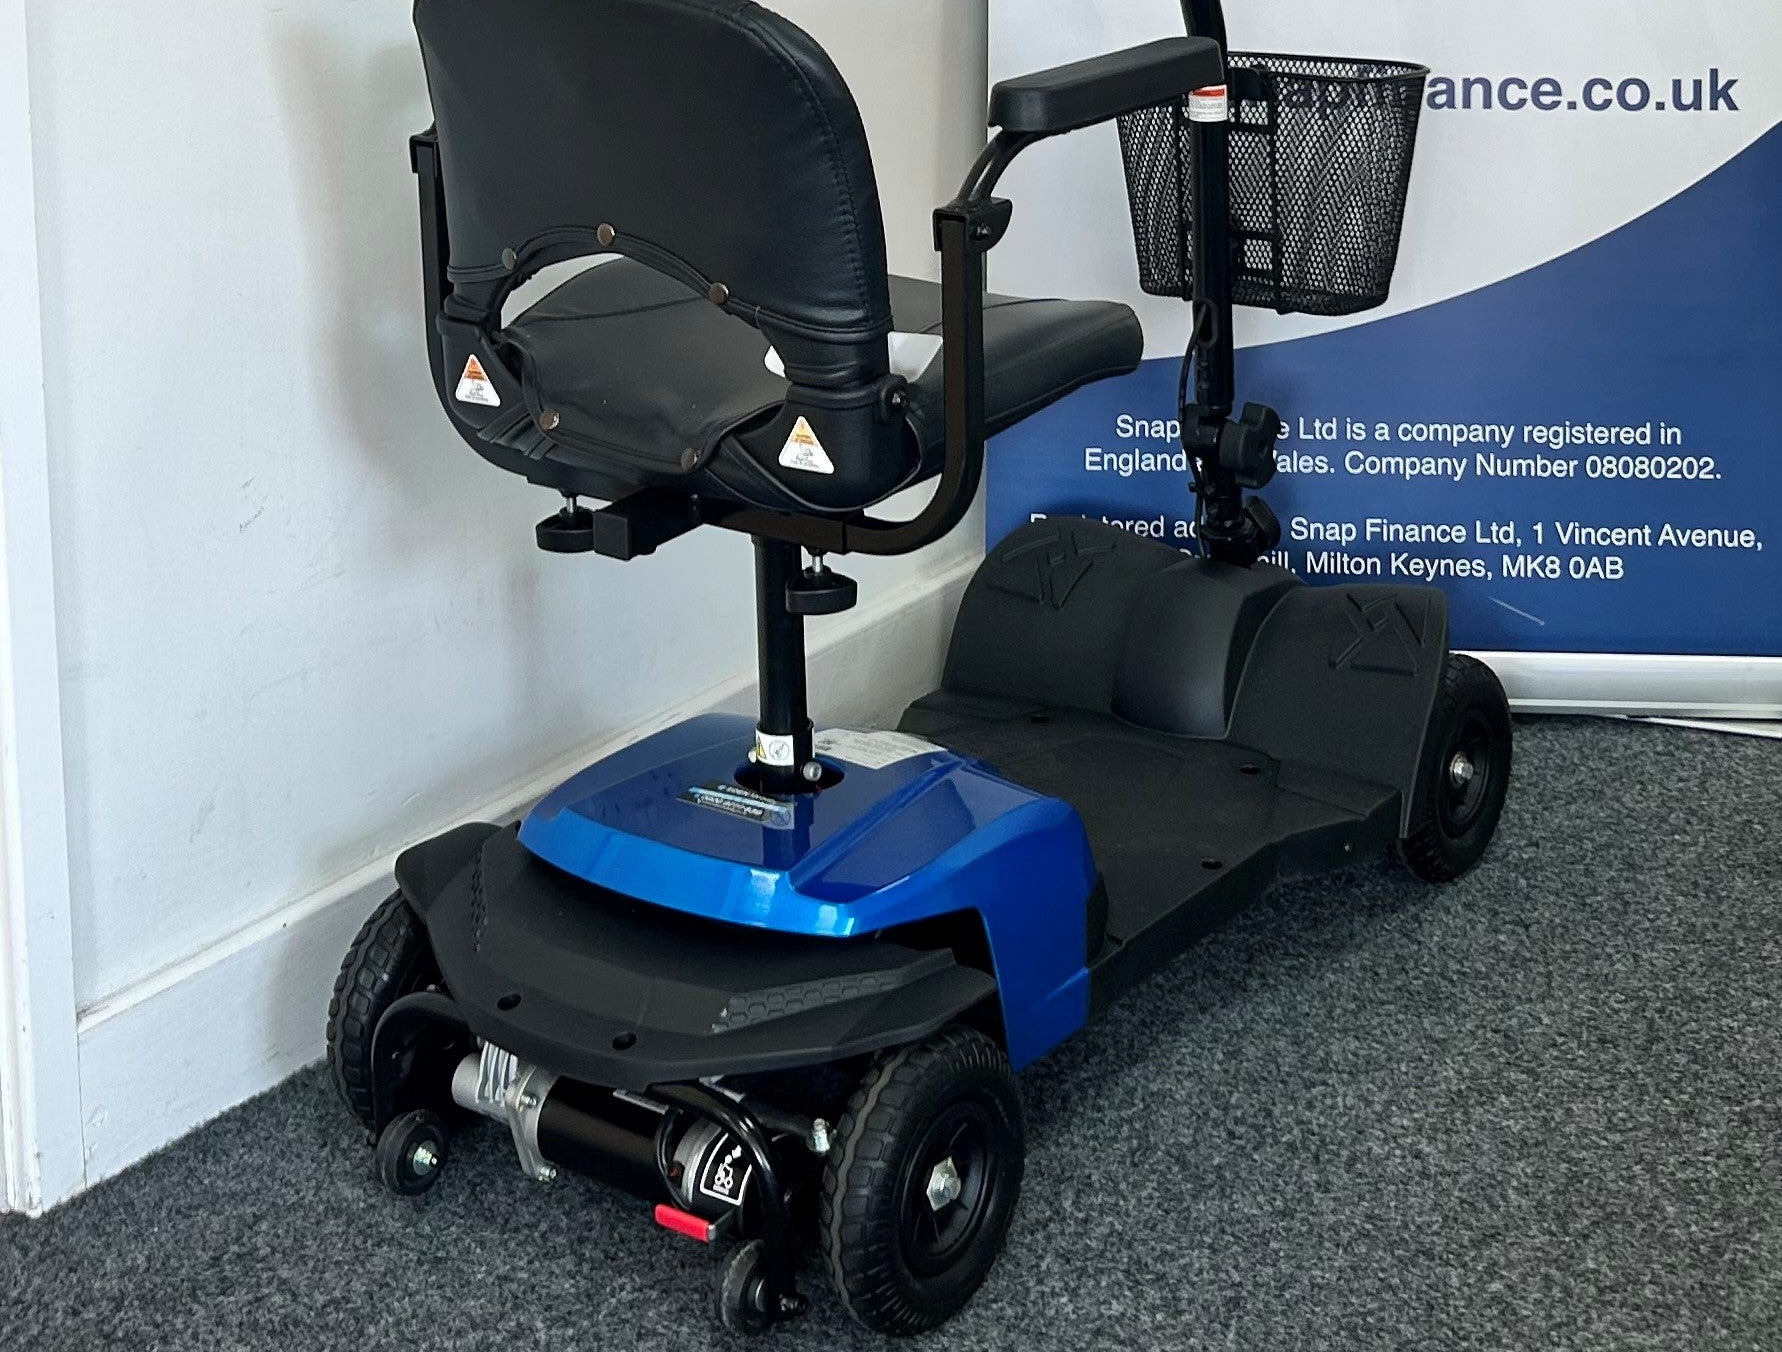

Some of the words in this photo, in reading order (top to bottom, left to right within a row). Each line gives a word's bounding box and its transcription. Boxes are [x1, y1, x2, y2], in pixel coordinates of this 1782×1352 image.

[1115, 413, 1182, 445] Snap
[1298, 415, 1338, 441] Ltd
[1345, 416, 1367, 442] is
[1374, 422, 1391, 442] a
[1397, 422, 1515, 450] company
[1523, 420, 1652, 451] registered
[1659, 420, 1683, 446] in
[1084, 446, 1187, 478] England
[1272, 449, 1335, 474] ales.
[1344, 450, 1469, 482] Company
[1475, 452, 1579, 479] Number
[1584, 454, 1722, 481] 08080202.
[1290, 516, 1358, 547] Snap
[1365, 518, 1467, 545] Finance
[1475, 519, 1523, 549] Ltd,
[1531, 521, 1543, 546] 1
[1553, 521, 1652, 547] Vincent
[1657, 523, 1763, 551] Avenue,
[1305, 550, 1382, 576] Milton
[1389, 552, 1493, 583] Keynes,
[1501, 554, 1562, 580] MK8
[1567, 555, 1624, 581] 0AB
